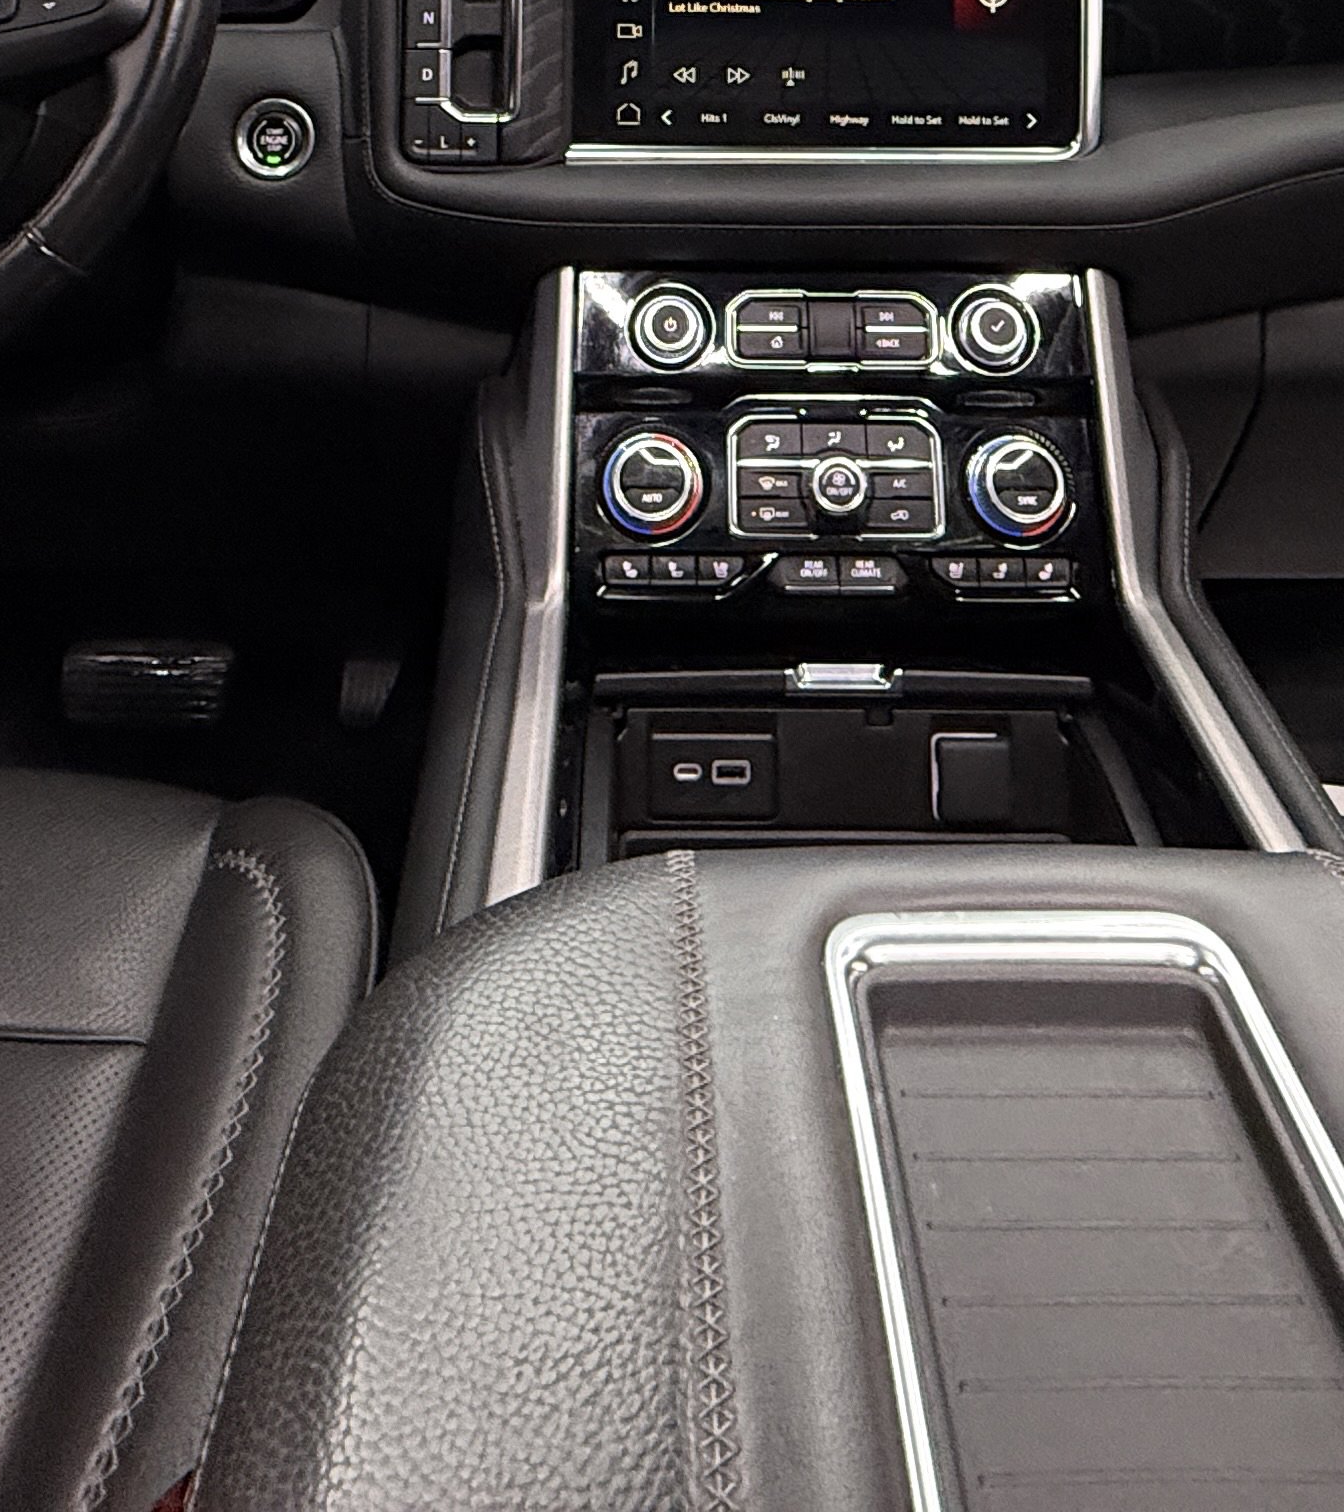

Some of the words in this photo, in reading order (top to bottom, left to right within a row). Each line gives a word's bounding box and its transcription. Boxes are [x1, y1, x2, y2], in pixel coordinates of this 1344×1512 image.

[668, 2, 687, 13] Lot
[687, 2, 709, 13] Like
[709, 2, 762, 14] Christmas
[422, 12, 435, 24] N
[421, 68, 434, 82] D
[829, 114, 870, 127] Highway
[891, 115, 913, 125] Hold
[914, 115, 925, 125] to
[926, 115, 943, 125] Set
[958, 115, 981, 126] Hold
[993, 116, 1010, 126] Set
[260, 135, 289, 145] ENGINE
[440, 136, 448, 148] L
[892, 479, 907, 489] A/C
[826, 487, 854, 496] ON/OFF
[641, 493, 663, 504] AUTO
[1017, 495, 1038, 506] SYNC
[804, 559, 824, 569] REAR
[855, 559, 875, 568] REAR
[850, 568, 882, 578] CLIMATE
